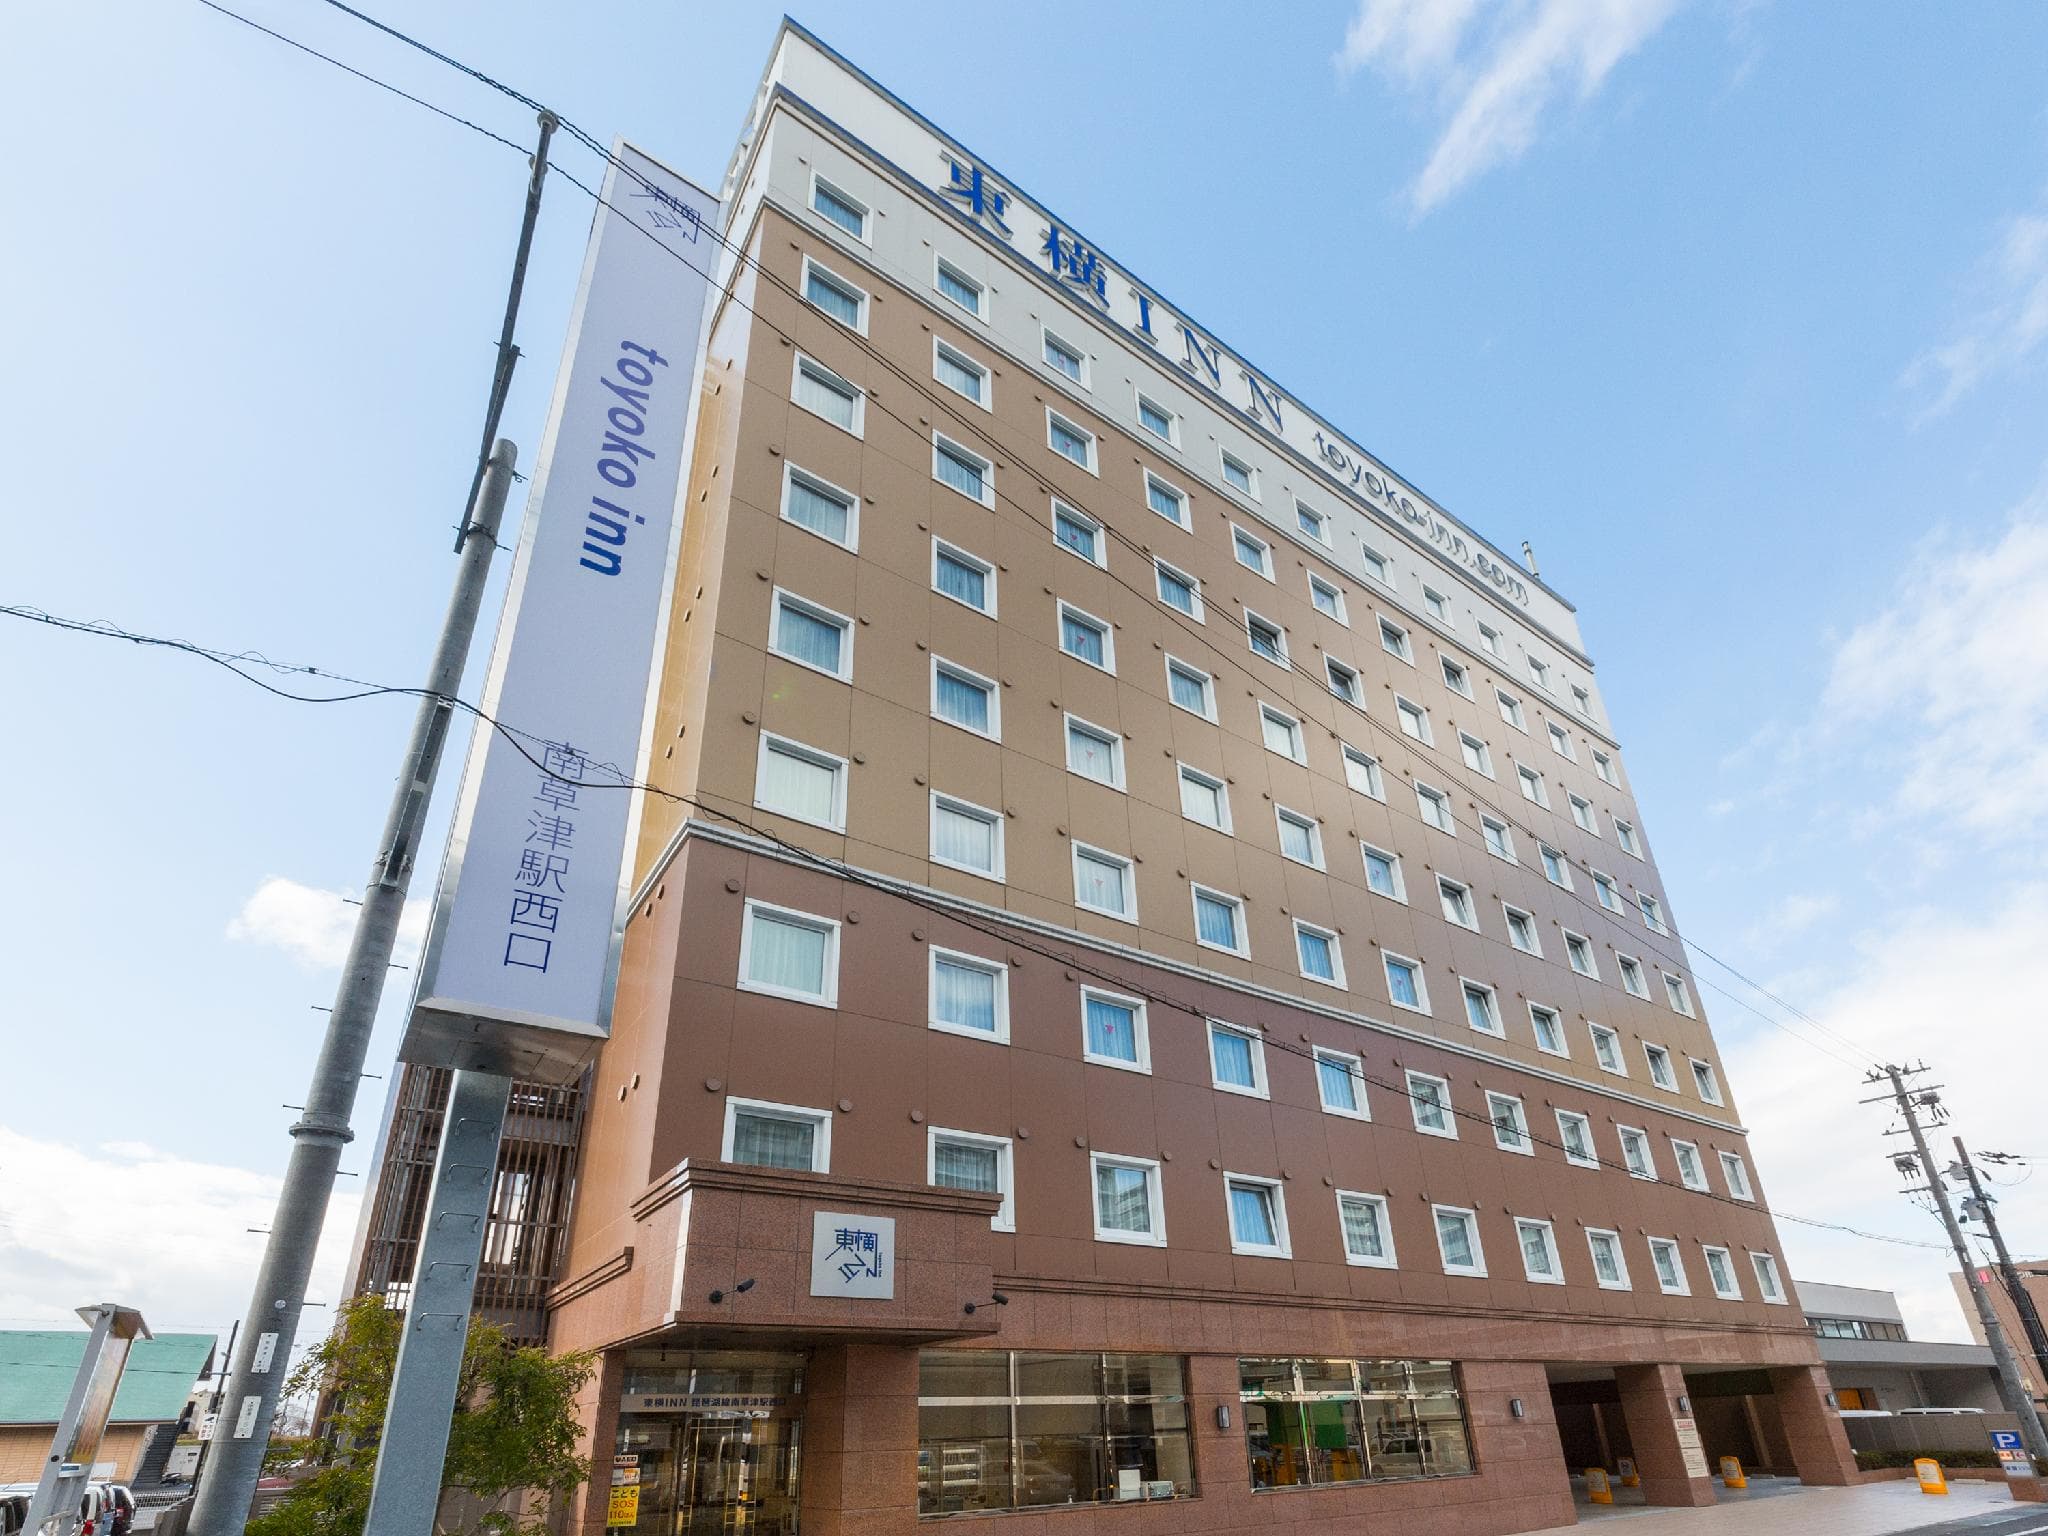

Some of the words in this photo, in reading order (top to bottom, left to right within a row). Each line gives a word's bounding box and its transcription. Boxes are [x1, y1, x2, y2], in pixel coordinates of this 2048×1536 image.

[939, 150, 1284, 435] 東横INN
[597, 340, 669, 489] toyoko
[579, 495, 646, 577] inn
[1312, 430, 1529, 606] toyoko-inn.com
[504, 739, 589, 974] 南草津駅西口
[611, 1489, 638, 1499] こども
[1996, 1433, 2016, 1448] P
[612, 1500, 635, 1509] SOS
